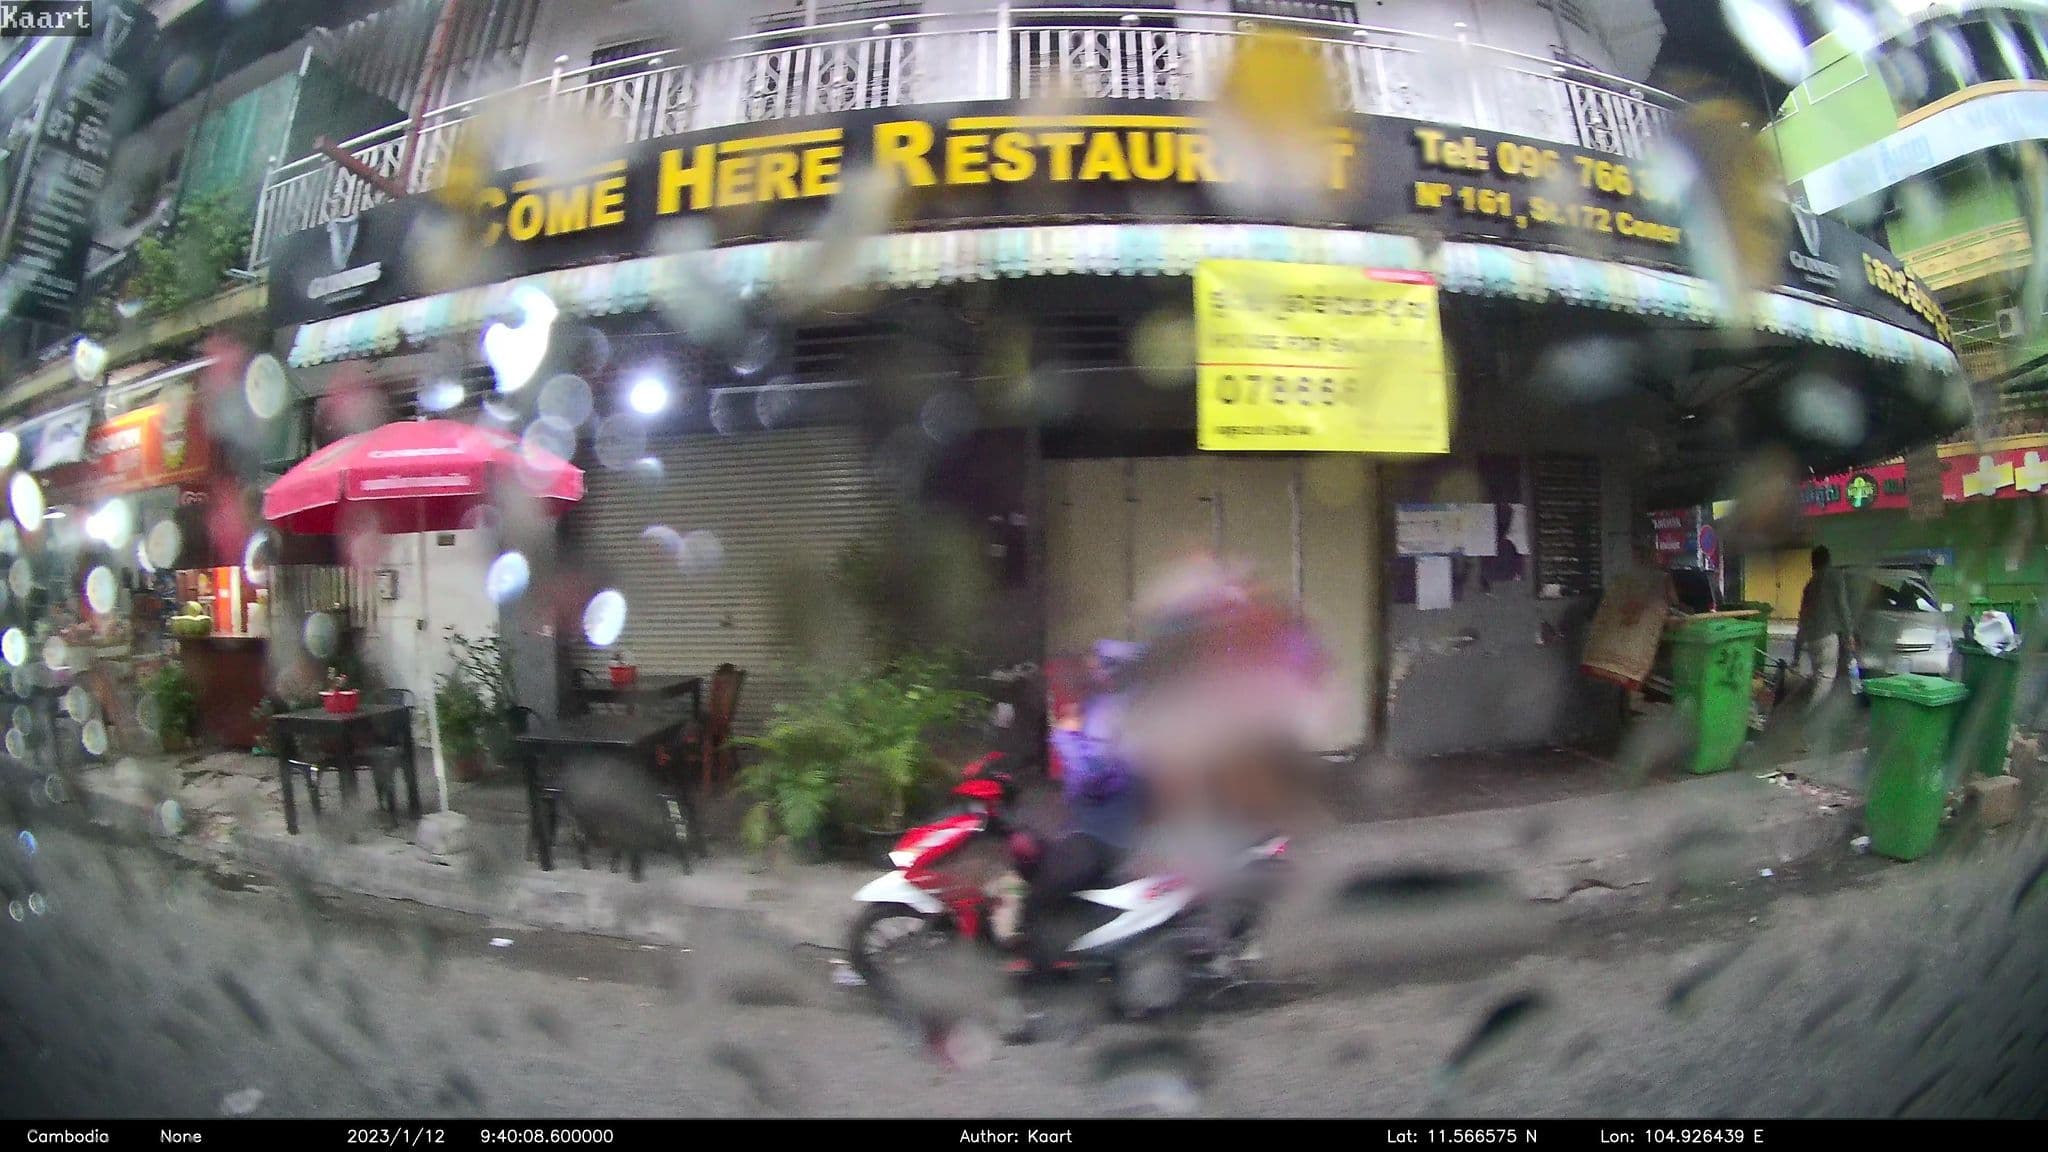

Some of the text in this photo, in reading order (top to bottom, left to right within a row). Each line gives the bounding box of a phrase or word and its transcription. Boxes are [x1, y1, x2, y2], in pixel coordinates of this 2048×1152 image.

[656, 142, 844, 215] HERE
[872, 117, 1356, 190] RESTAURT
[1414, 128, 1490, 171] Tel:
